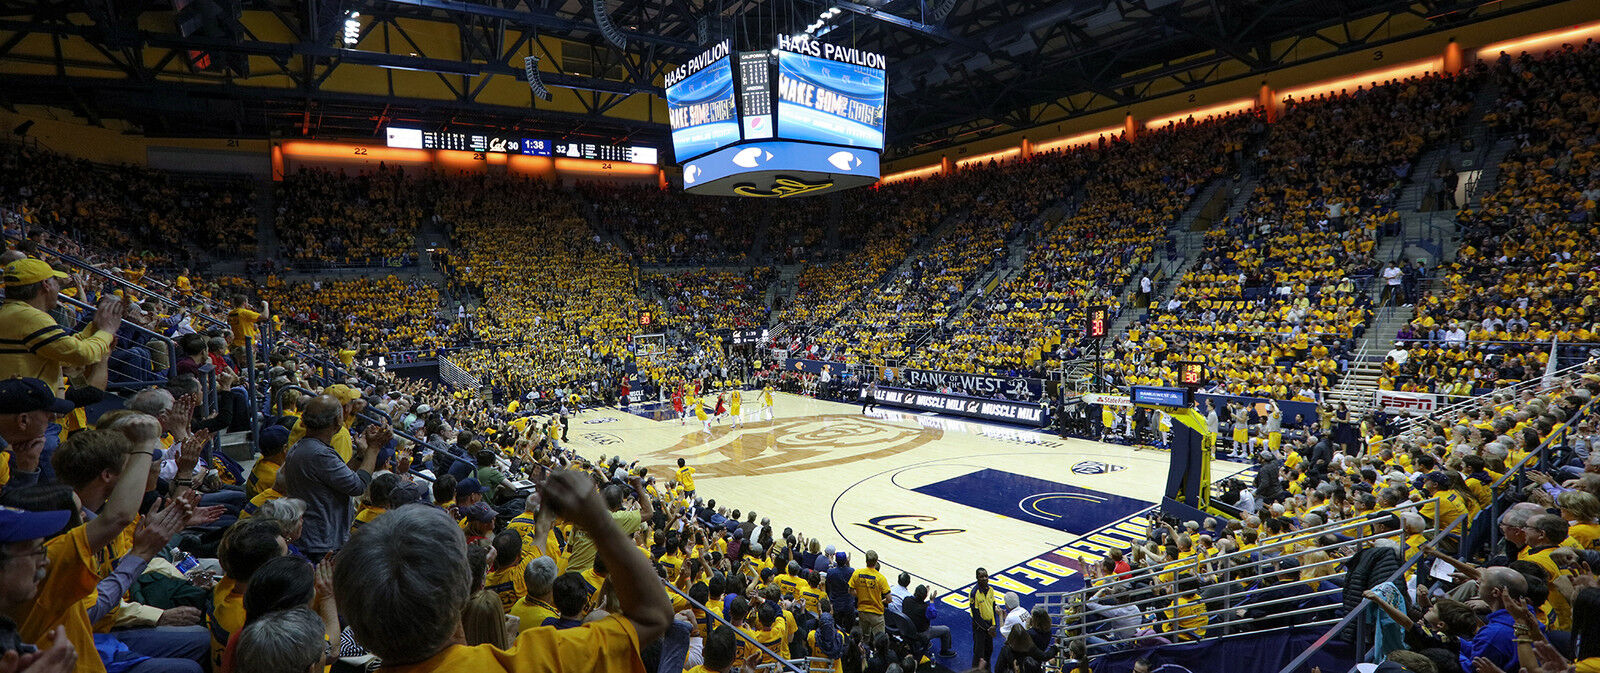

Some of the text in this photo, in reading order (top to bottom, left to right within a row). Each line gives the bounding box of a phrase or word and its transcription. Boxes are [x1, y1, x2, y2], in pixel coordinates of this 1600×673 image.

[779, 33, 886, 70] HAAS PAVILION
[1373, 50, 1384, 61] 3
[664, 67, 686, 88] HAAS
[688, 39, 730, 76] PAVILION
[779, 72, 815, 107] MAKE
[815, 87, 849, 117] SOME
[1188, 93, 1196, 103] 2
[668, 106, 689, 130] MAKE
[689, 102, 710, 126] SOME
[227, 139, 239, 147] 21
[489, 137, 507, 152] Cal
[507, 141, 519, 151] 30
[524, 139, 544, 150] 1:38
[556, 145, 566, 154] 32
[354, 147, 368, 156] 22
[473, 152, 486, 161] 23
[733, 178, 834, 199] Cal
[641, 316, 650, 325] 30
[1092, 319, 1104, 336] 30
[911, 370, 947, 387] BANK
[948, 381, 960, 389] THE
[949, 374, 958, 382] OF
[960, 375, 1005, 392] WEST
[1186, 372, 1198, 383] 30
[886, 391, 904, 403] MILK
[904, 393, 915, 404] Cal
[916, 394, 946, 409] MUSCLE
[946, 398, 967, 412] MILK
[966, 400, 980, 413] Cal
[981, 402, 1018, 418] MUSCLE
[1017, 407, 1042, 421] MILK
[1104, 396, 1117, 404] State
[1381, 395, 1432, 410] ESPN
[849, 513, 967, 544] Cal
